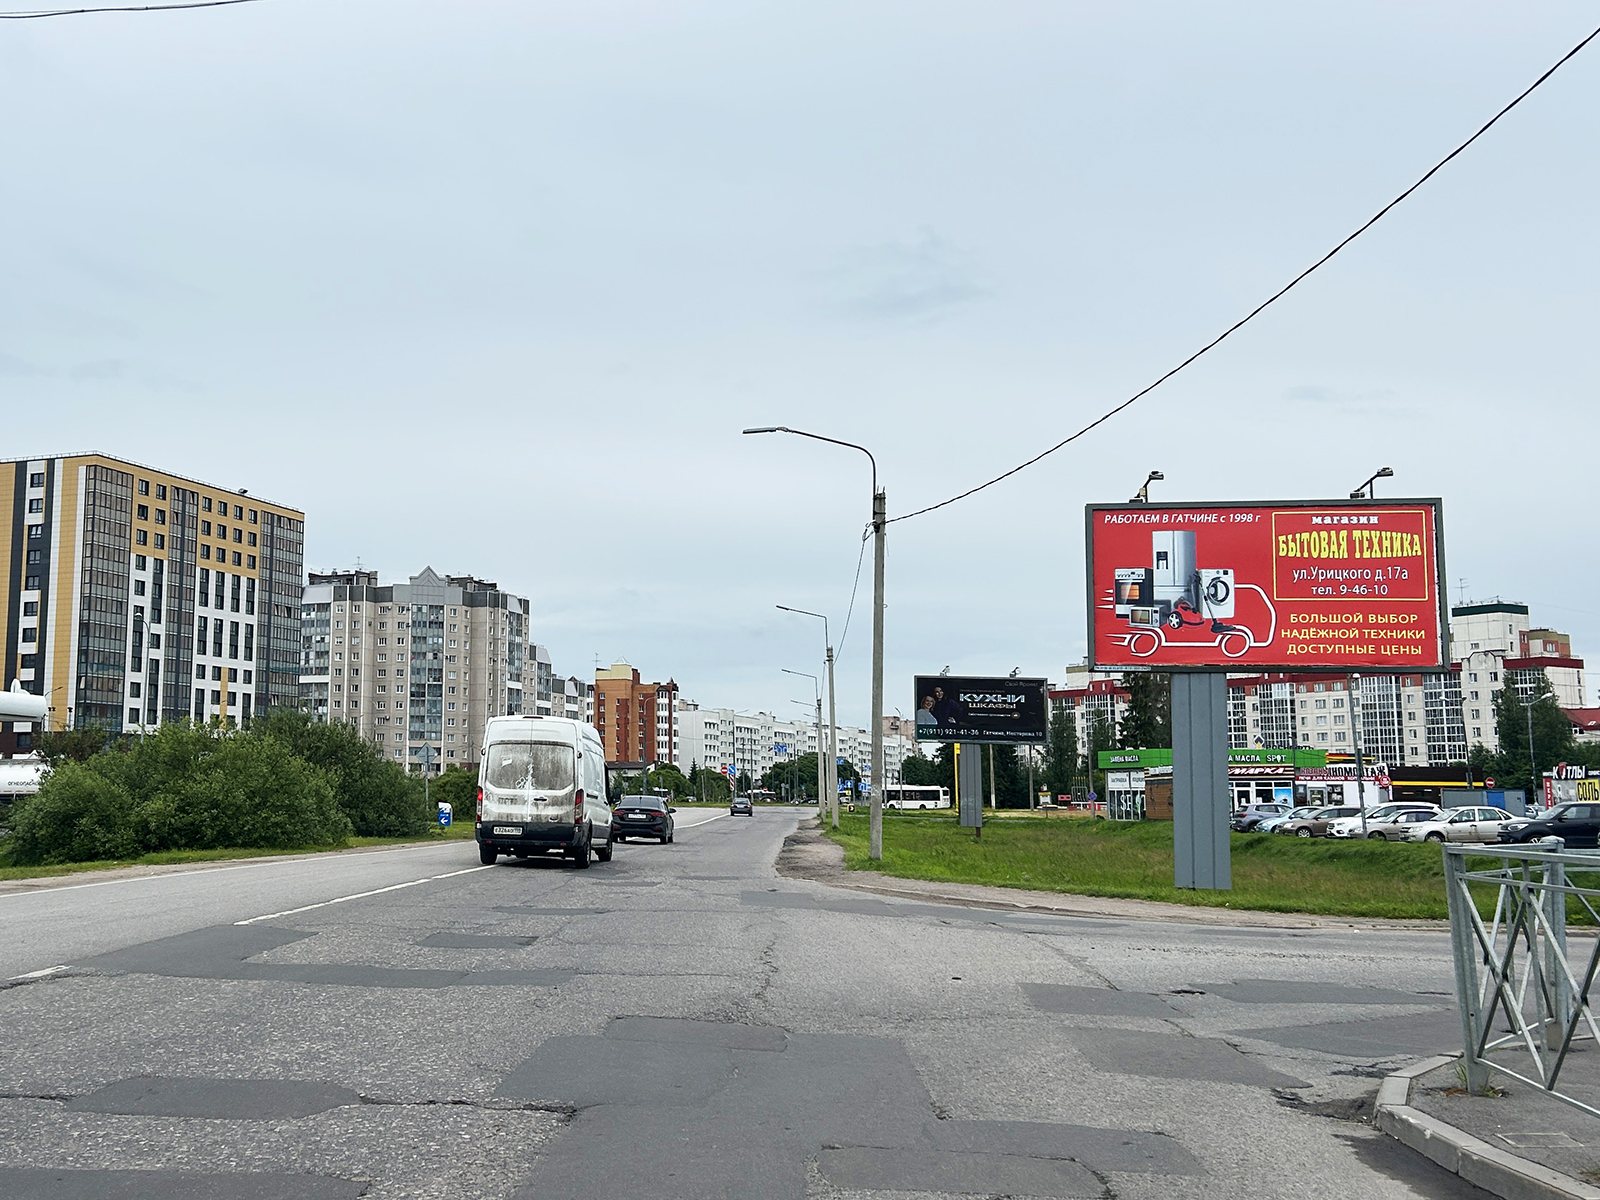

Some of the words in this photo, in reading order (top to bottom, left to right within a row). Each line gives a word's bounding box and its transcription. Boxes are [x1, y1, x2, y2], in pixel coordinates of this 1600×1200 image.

[1104, 514, 1160, 524] РАБОТАЕМ
[1162, 514, 1169, 523] В
[1171, 513, 1219, 523] ГАТЧИНЕ
[1229, 513, 1253, 523] 1998
[1255, 515, 1261, 523] г
[1311, 516, 1379, 524] магазин
[1278, 530, 1349, 559] БЫТОВАЯ
[1352, 530, 1422, 559] ТЕХНИКА
[1292, 566, 1371, 583] ул.Урицкого
[1374, 566, 1409, 582] д.17а
[1311, 586, 1336, 595] тел.
[1339, 585, 1388, 595] 9-46-10
[1290, 612, 1363, 623] БОЛЬШОЙ
[1368, 614, 1418, 623] ВЫБОР
[1281, 628, 1360, 640] НАДЁЖНОЙ
[1362, 629, 1425, 639] ТЕХНИКИ
[1287, 644, 1376, 655] ДОСТУПНЫЕ
[1381, 645, 1422, 656] ЦЕНЫ
[959, 693, 1025, 703] КУХНИ
[945, 728, 979, 736] 921-41-36
[1235, 754, 1261, 762] МАСЛА
[1228, 767, 1285, 775] МАРКА
[1577, 781, 1599, 801] СОЛЬ
